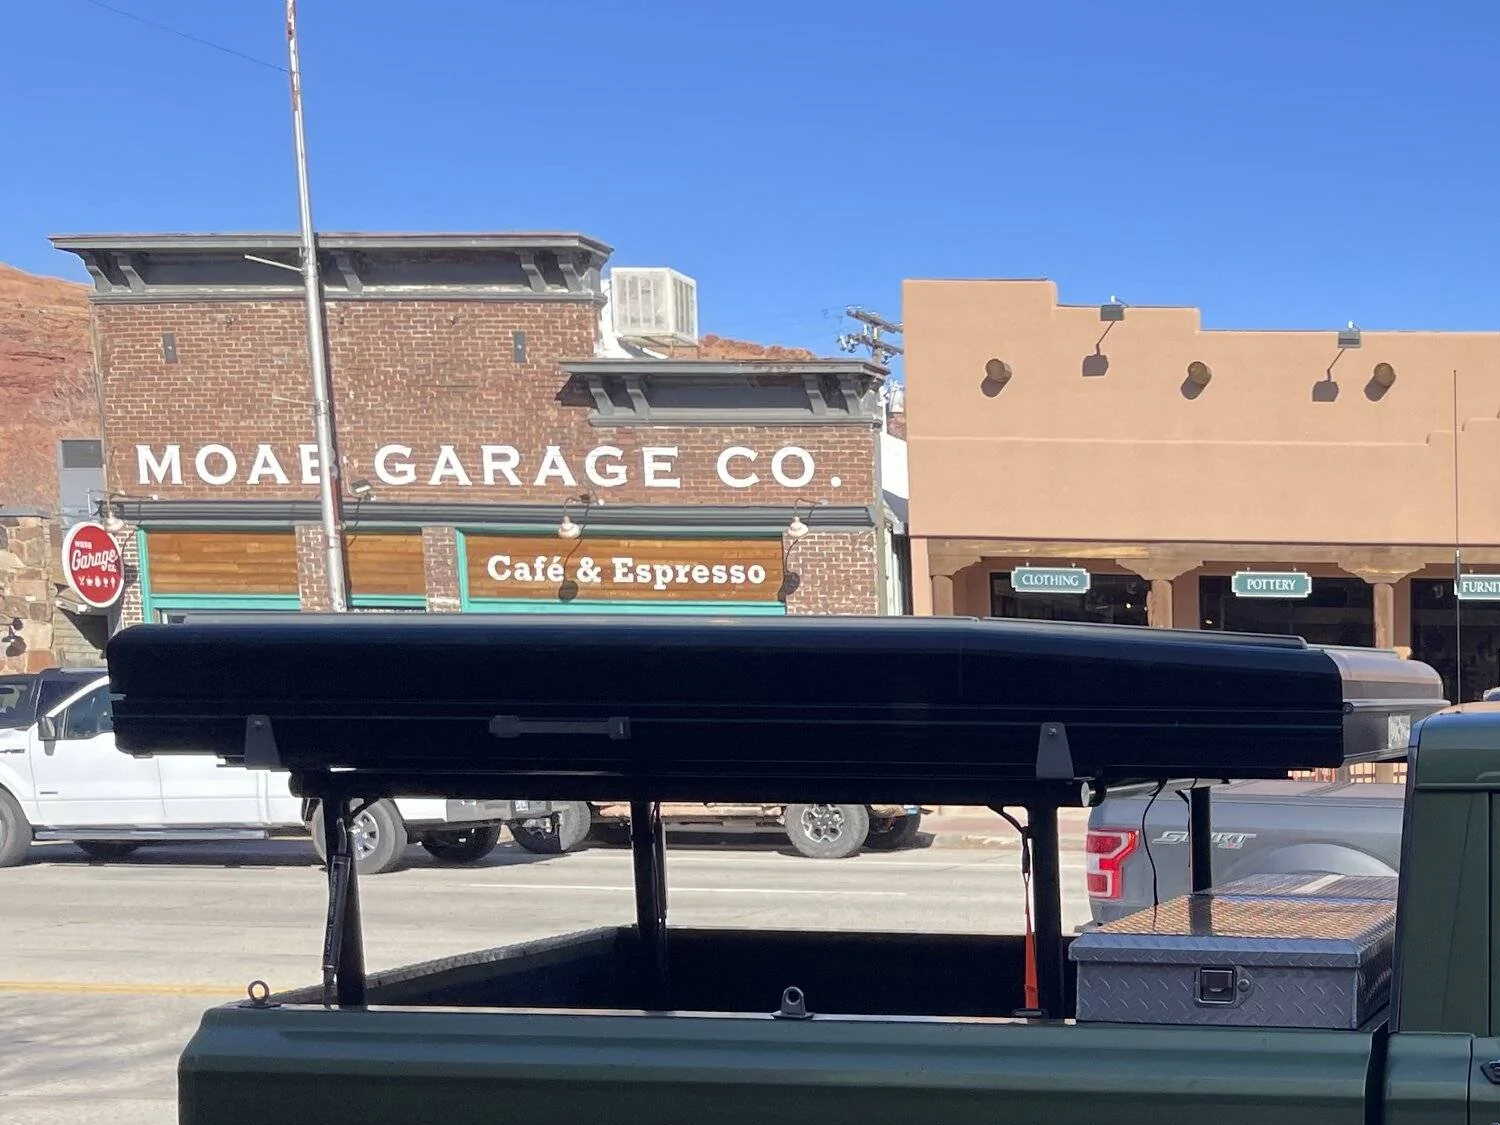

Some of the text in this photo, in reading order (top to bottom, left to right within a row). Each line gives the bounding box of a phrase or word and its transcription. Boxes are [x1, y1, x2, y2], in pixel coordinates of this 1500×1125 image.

[374, 444, 682, 489] GARAGE
[716, 446, 842, 489] CO.
[71, 549, 118, 572] Garage
[486, 555, 767, 590] Café & Espresso
[1022, 573, 1080, 586] CLOTHING
[1247, 578, 1296, 591] POTTERY
